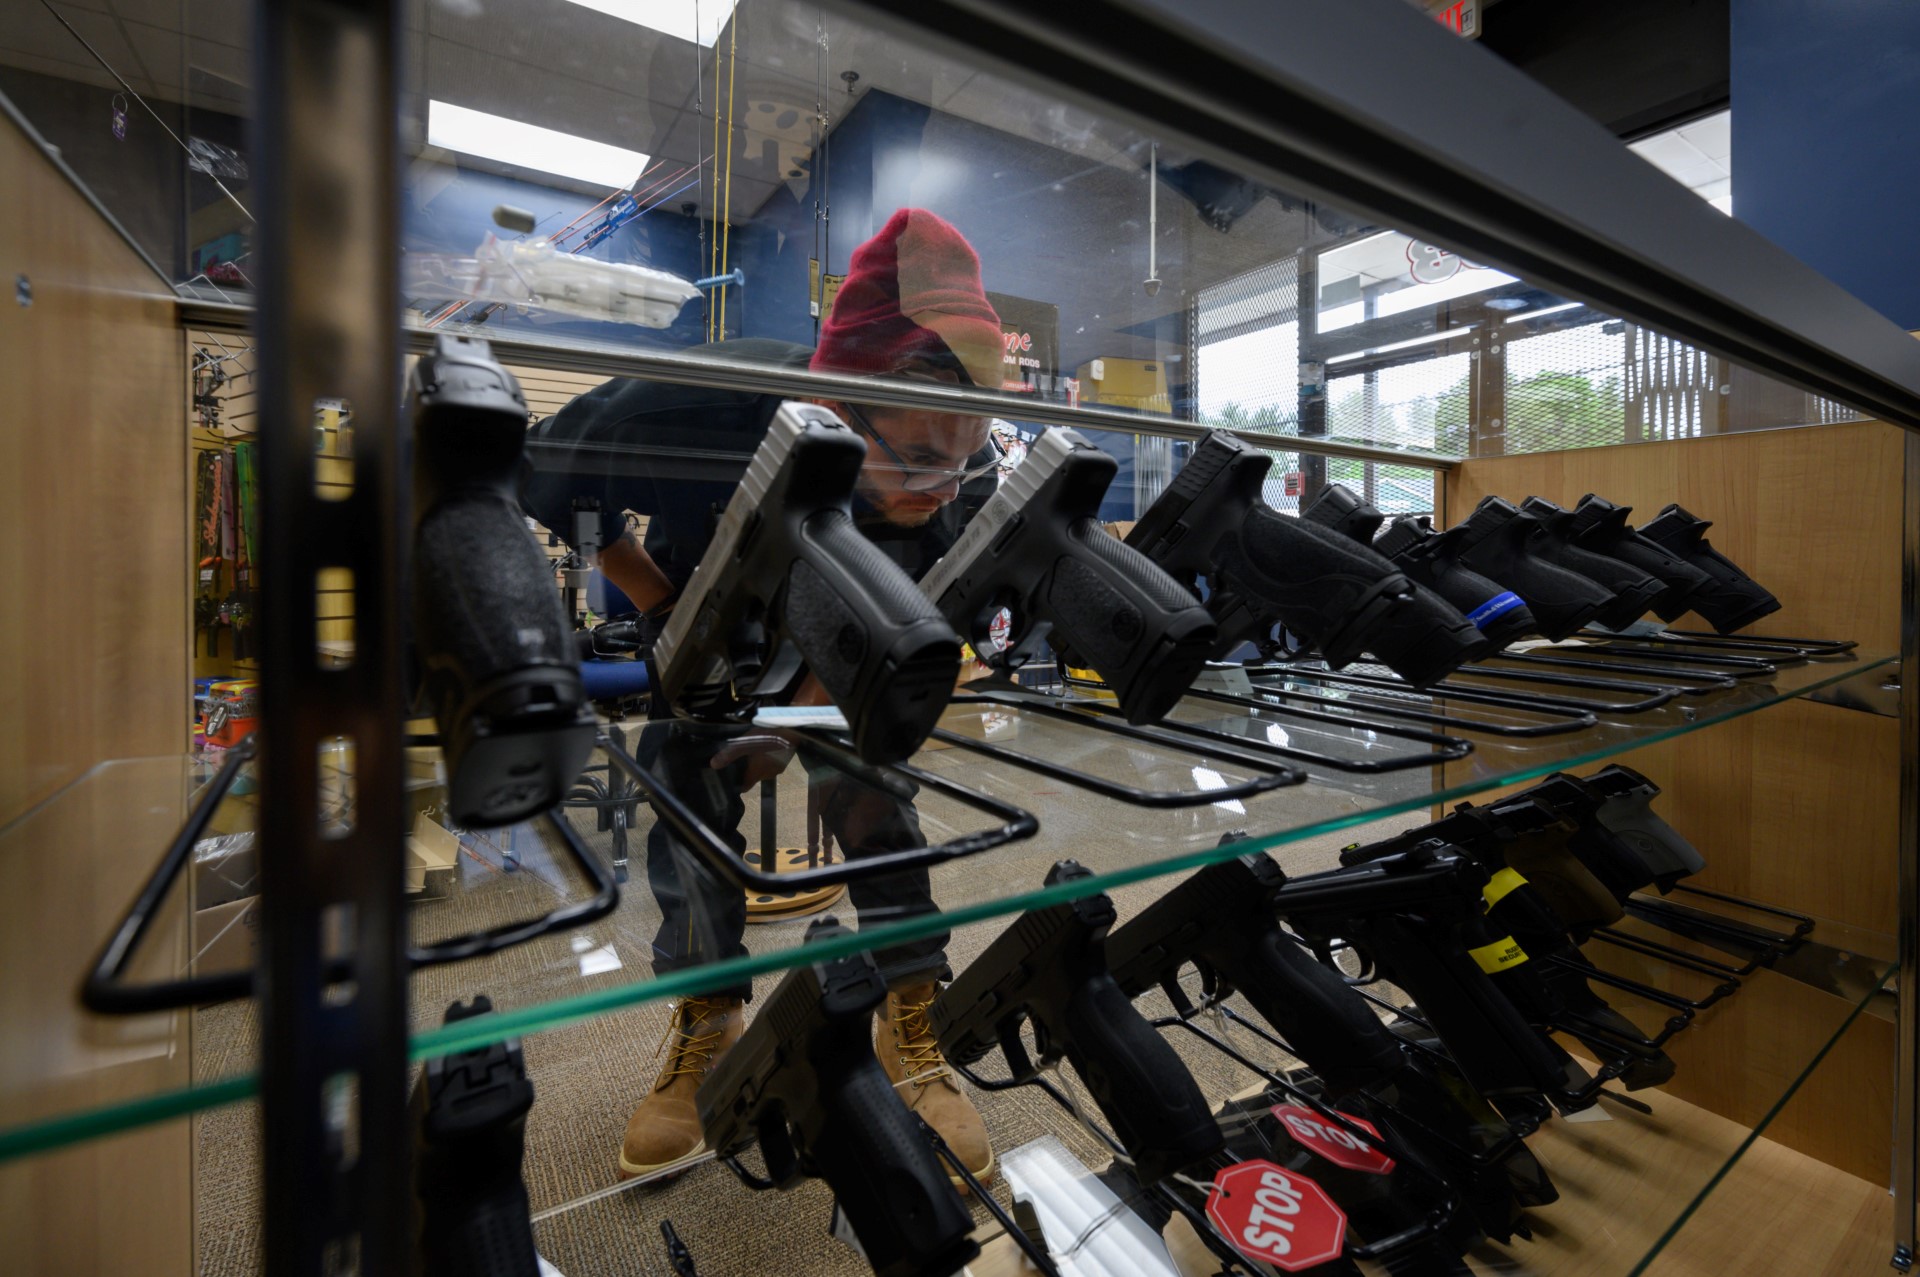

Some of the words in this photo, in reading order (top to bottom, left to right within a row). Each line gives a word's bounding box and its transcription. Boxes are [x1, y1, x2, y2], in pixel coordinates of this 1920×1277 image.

[1435, 0, 1465, 36] IT
[1003, 355, 1016, 365] OM
[1019, 357, 1040, 368] RODS
[1243, 1171, 1303, 1256] STOP
